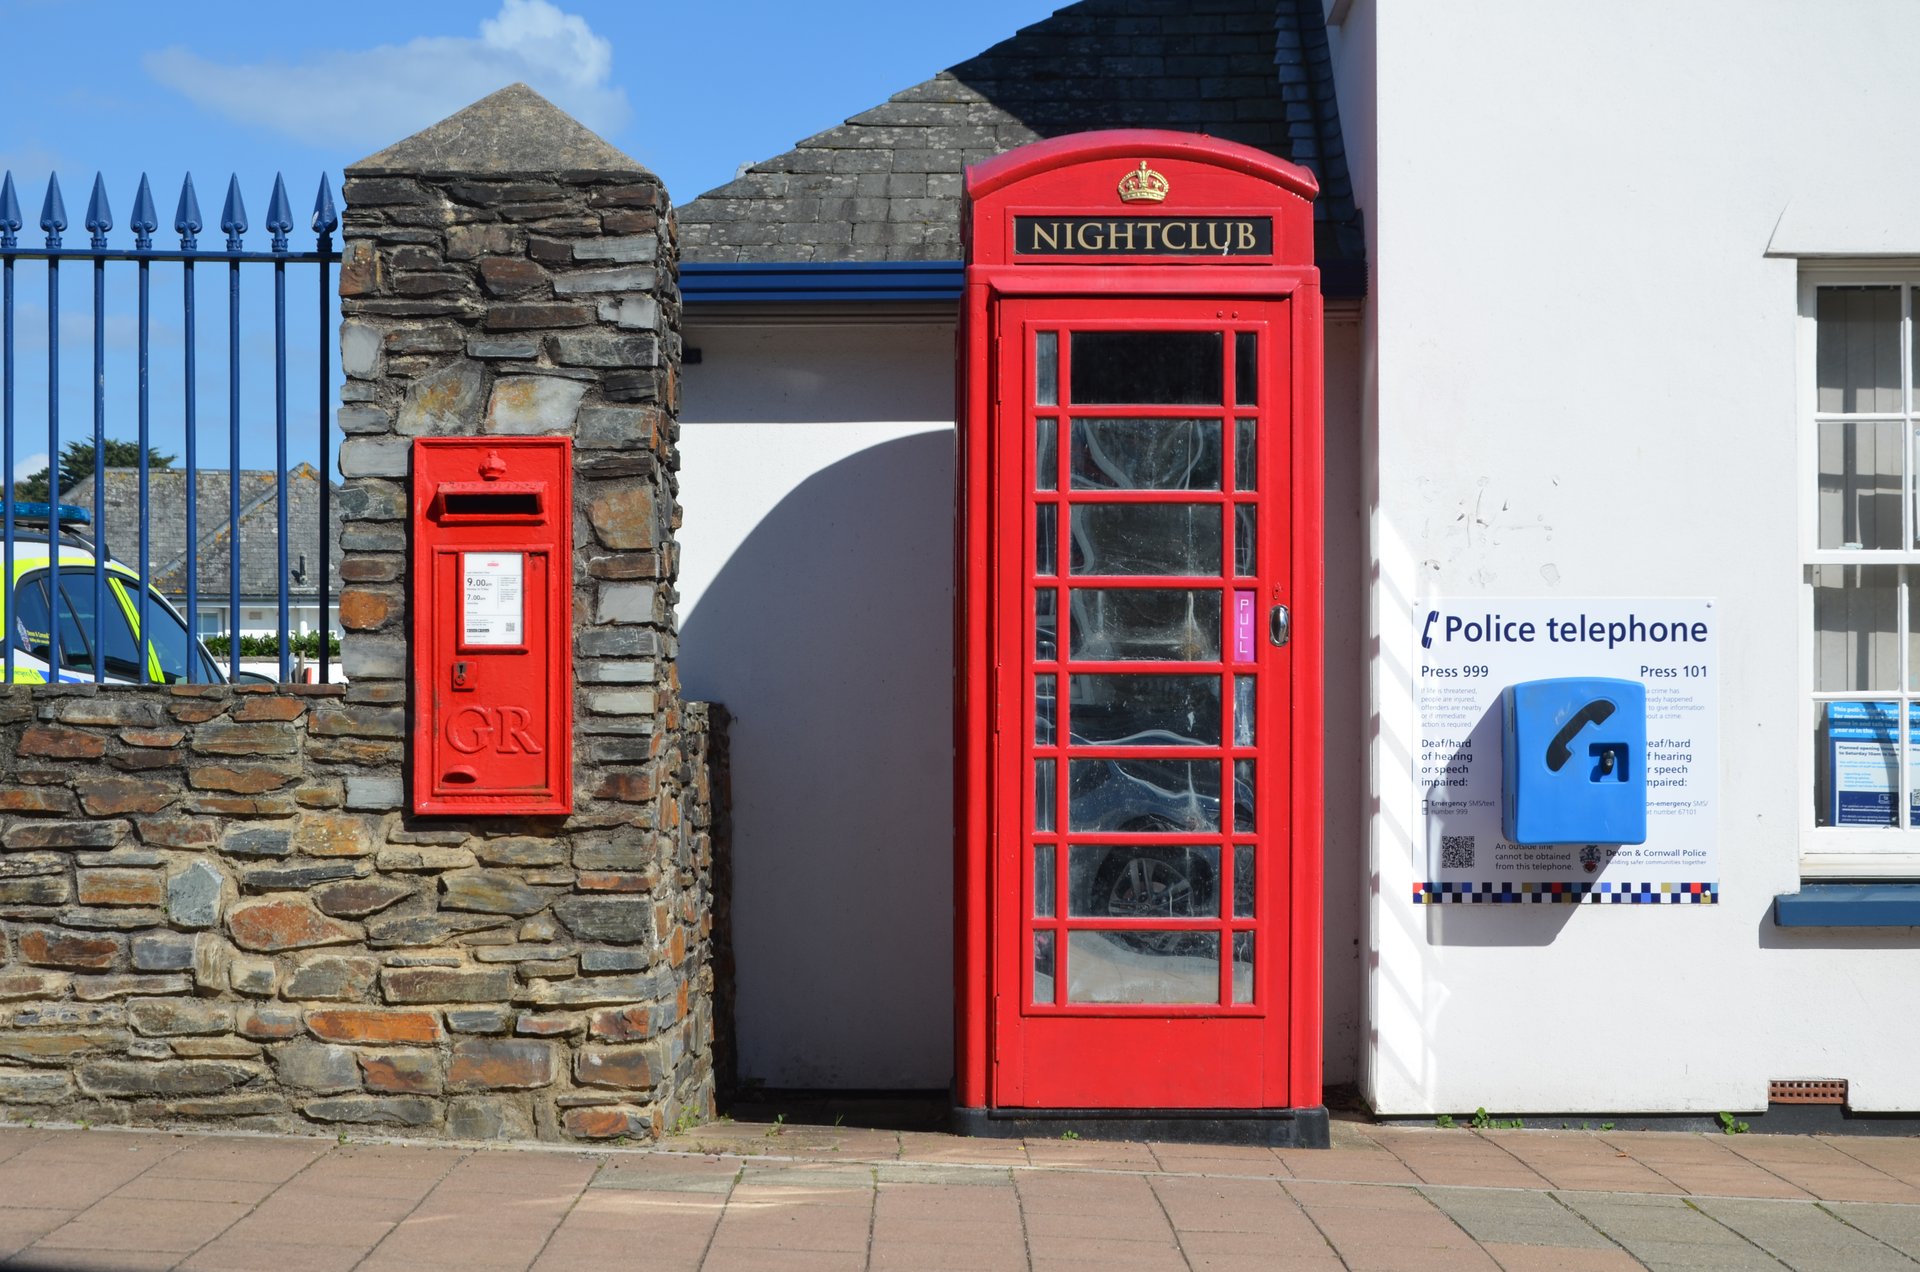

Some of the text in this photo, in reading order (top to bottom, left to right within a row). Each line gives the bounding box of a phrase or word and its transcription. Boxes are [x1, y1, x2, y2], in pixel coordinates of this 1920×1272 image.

[1032, 222, 1256, 250] NIGHTCLUB
[1239, 598, 1249, 654] PULL
[1445, 614, 1709, 650] Police telephone
[1421, 665, 1489, 678] Press 999
[1640, 665, 1707, 678] Press 101
[1461, 704, 1482, 712] nearby
[445, 705, 543, 755] GR
[1421, 738, 1472, 748] Deaf/hard
[1646, 738, 1691, 748] eaf/hard
[1421, 751, 1473, 763] of hearing
[1654, 751, 1692, 763] hearing
[1434, 765, 1469, 775] speech
[1654, 765, 1688, 775] speech
[1421, 777, 1468, 788] impaired:
[1646, 777, 1688, 788] mpaired:
[1431, 800, 1467, 808] Emergency
[1523, 852, 1534, 860] be
[1536, 852, 1571, 860] obtained
[1606, 849, 1707, 857] Devon & Cornwall Police
[1532, 863, 1574, 871] telephone.
